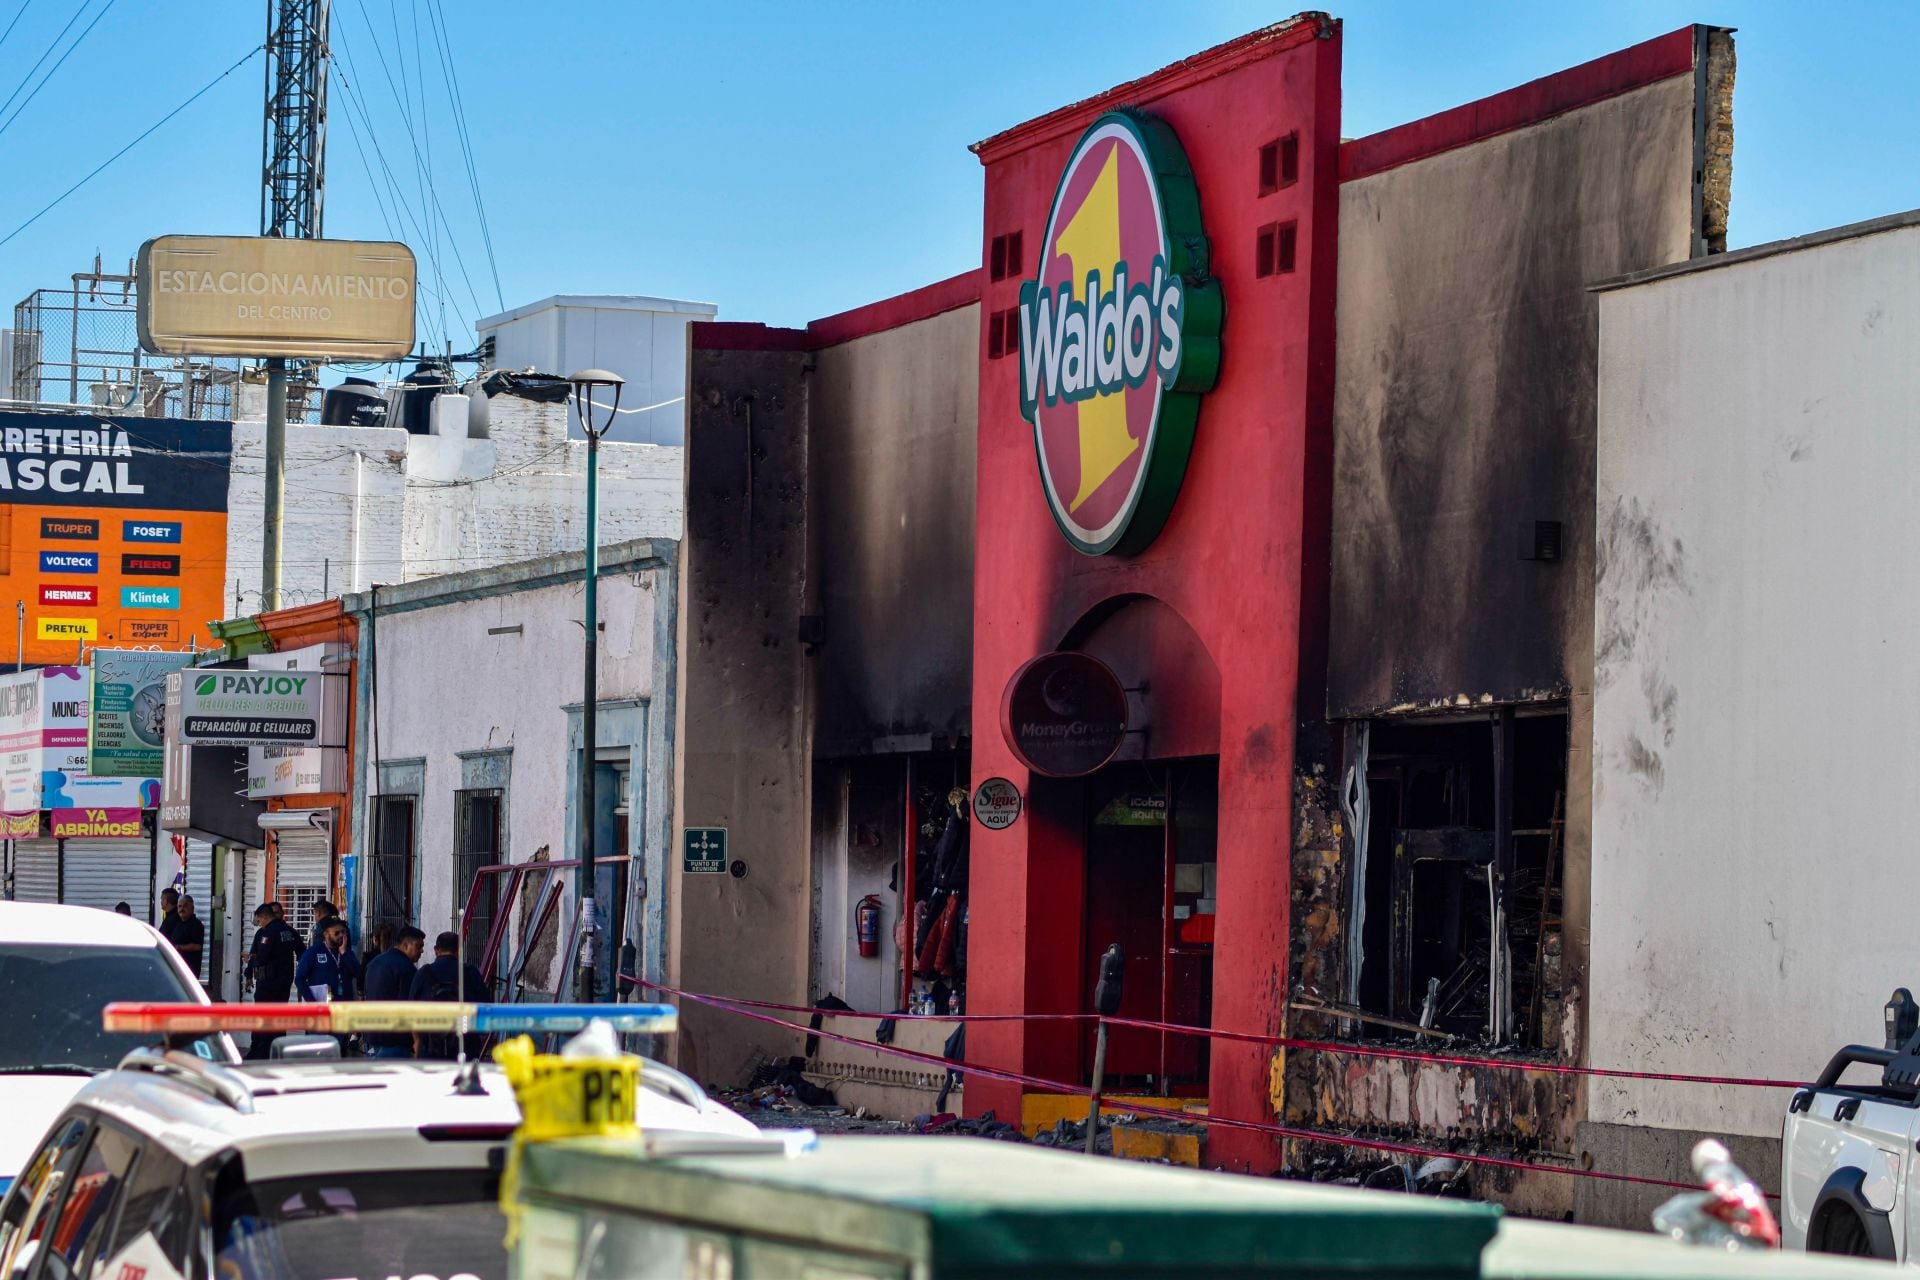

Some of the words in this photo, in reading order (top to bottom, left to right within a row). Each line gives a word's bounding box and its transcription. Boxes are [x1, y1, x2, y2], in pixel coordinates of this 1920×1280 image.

[159, 270, 409, 300] ESTACIONAMIENTO
[238, 305, 264, 318] DEL
[270, 305, 331, 321] CENTRO
[1020, 266, 1180, 401] Waldo's
[0, 424, 132, 457] RETERÍA
[47, 523, 92, 535] TRUPER
[133, 526, 170, 537] FOSET
[130, 560, 171, 569] FIERO
[45, 590, 91, 600] HERMEX
[130, 592, 170, 604] Klintek
[46, 624, 88, 634] PRETUL
[131, 623, 168, 633] TRUPER
[132, 630, 168, 639] expert
[223, 676, 307, 695] PAYJOY
[198, 699, 251, 712] CELULARES
[255, 701, 262, 711] A
[190, 720, 247, 732] REPARACIÓN
[249, 722, 260, 732] DE
[263, 723, 311, 734] CELULARES
[979, 786, 1016, 809] Sigue
[85, 810, 105, 822] YA
[987, 814, 1009, 823] AQUÍ
[54, 822, 140, 836] ABRIMOS!!
